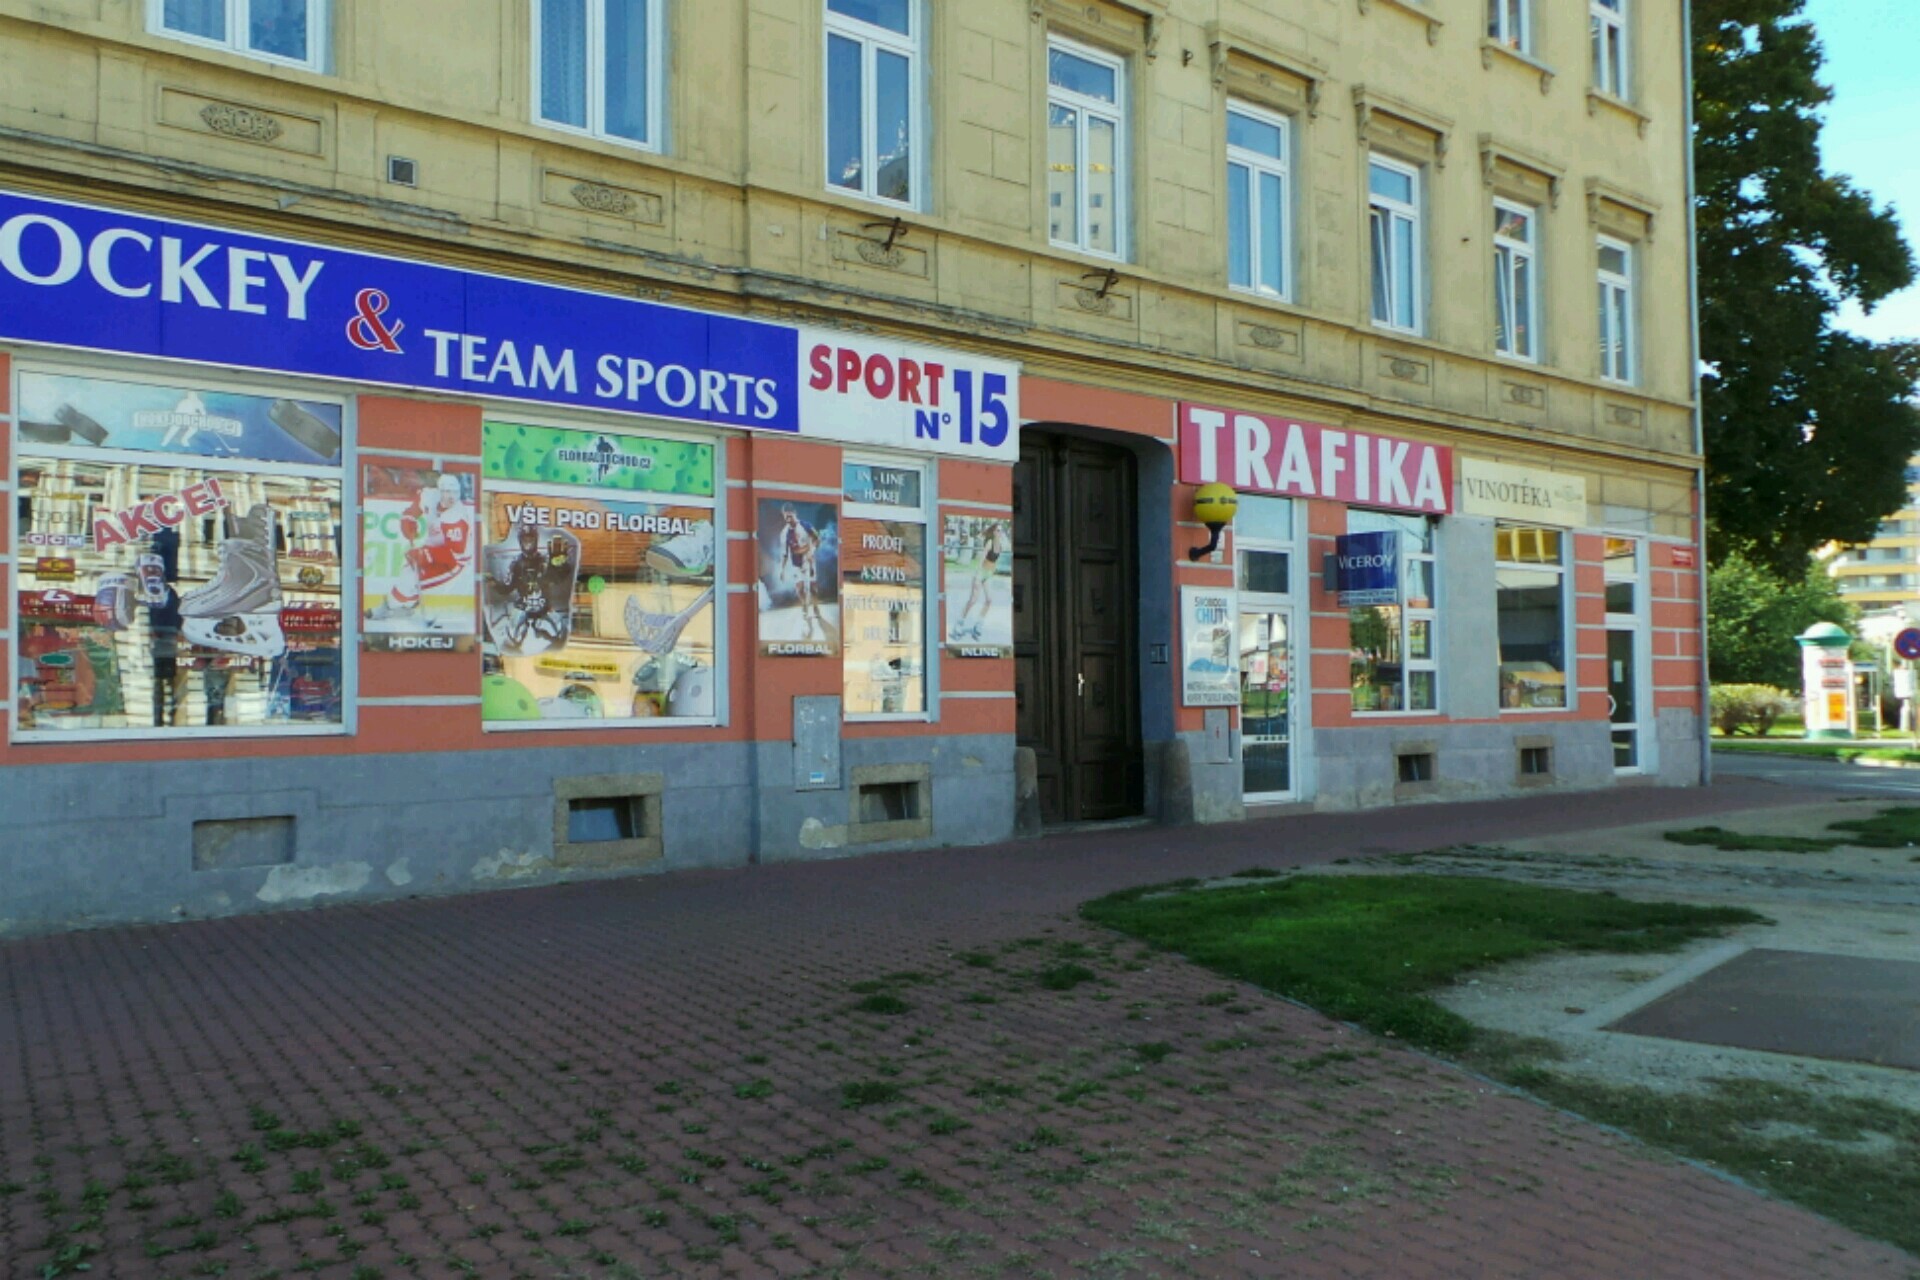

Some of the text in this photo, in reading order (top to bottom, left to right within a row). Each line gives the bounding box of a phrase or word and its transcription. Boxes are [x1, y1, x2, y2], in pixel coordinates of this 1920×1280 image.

[0, 213, 779, 420] OCKEY & TEAM SPORTS
[809, 344, 944, 406] SPORT
[953, 369, 1009, 447] 15
[1190, 407, 1446, 510] TRAFIKA
[1465, 477, 1552, 508] VINOTÉKA
[95, 478, 228, 553] AKCE!
[506, 501, 696, 535] VŠE PRO FLORBAL
[1339, 554, 1393, 570] VICEROY
[388, 636, 454, 649] HOKEJ
[767, 643, 834, 655] FLORBAL
[961, 647, 998, 657] INLINE
